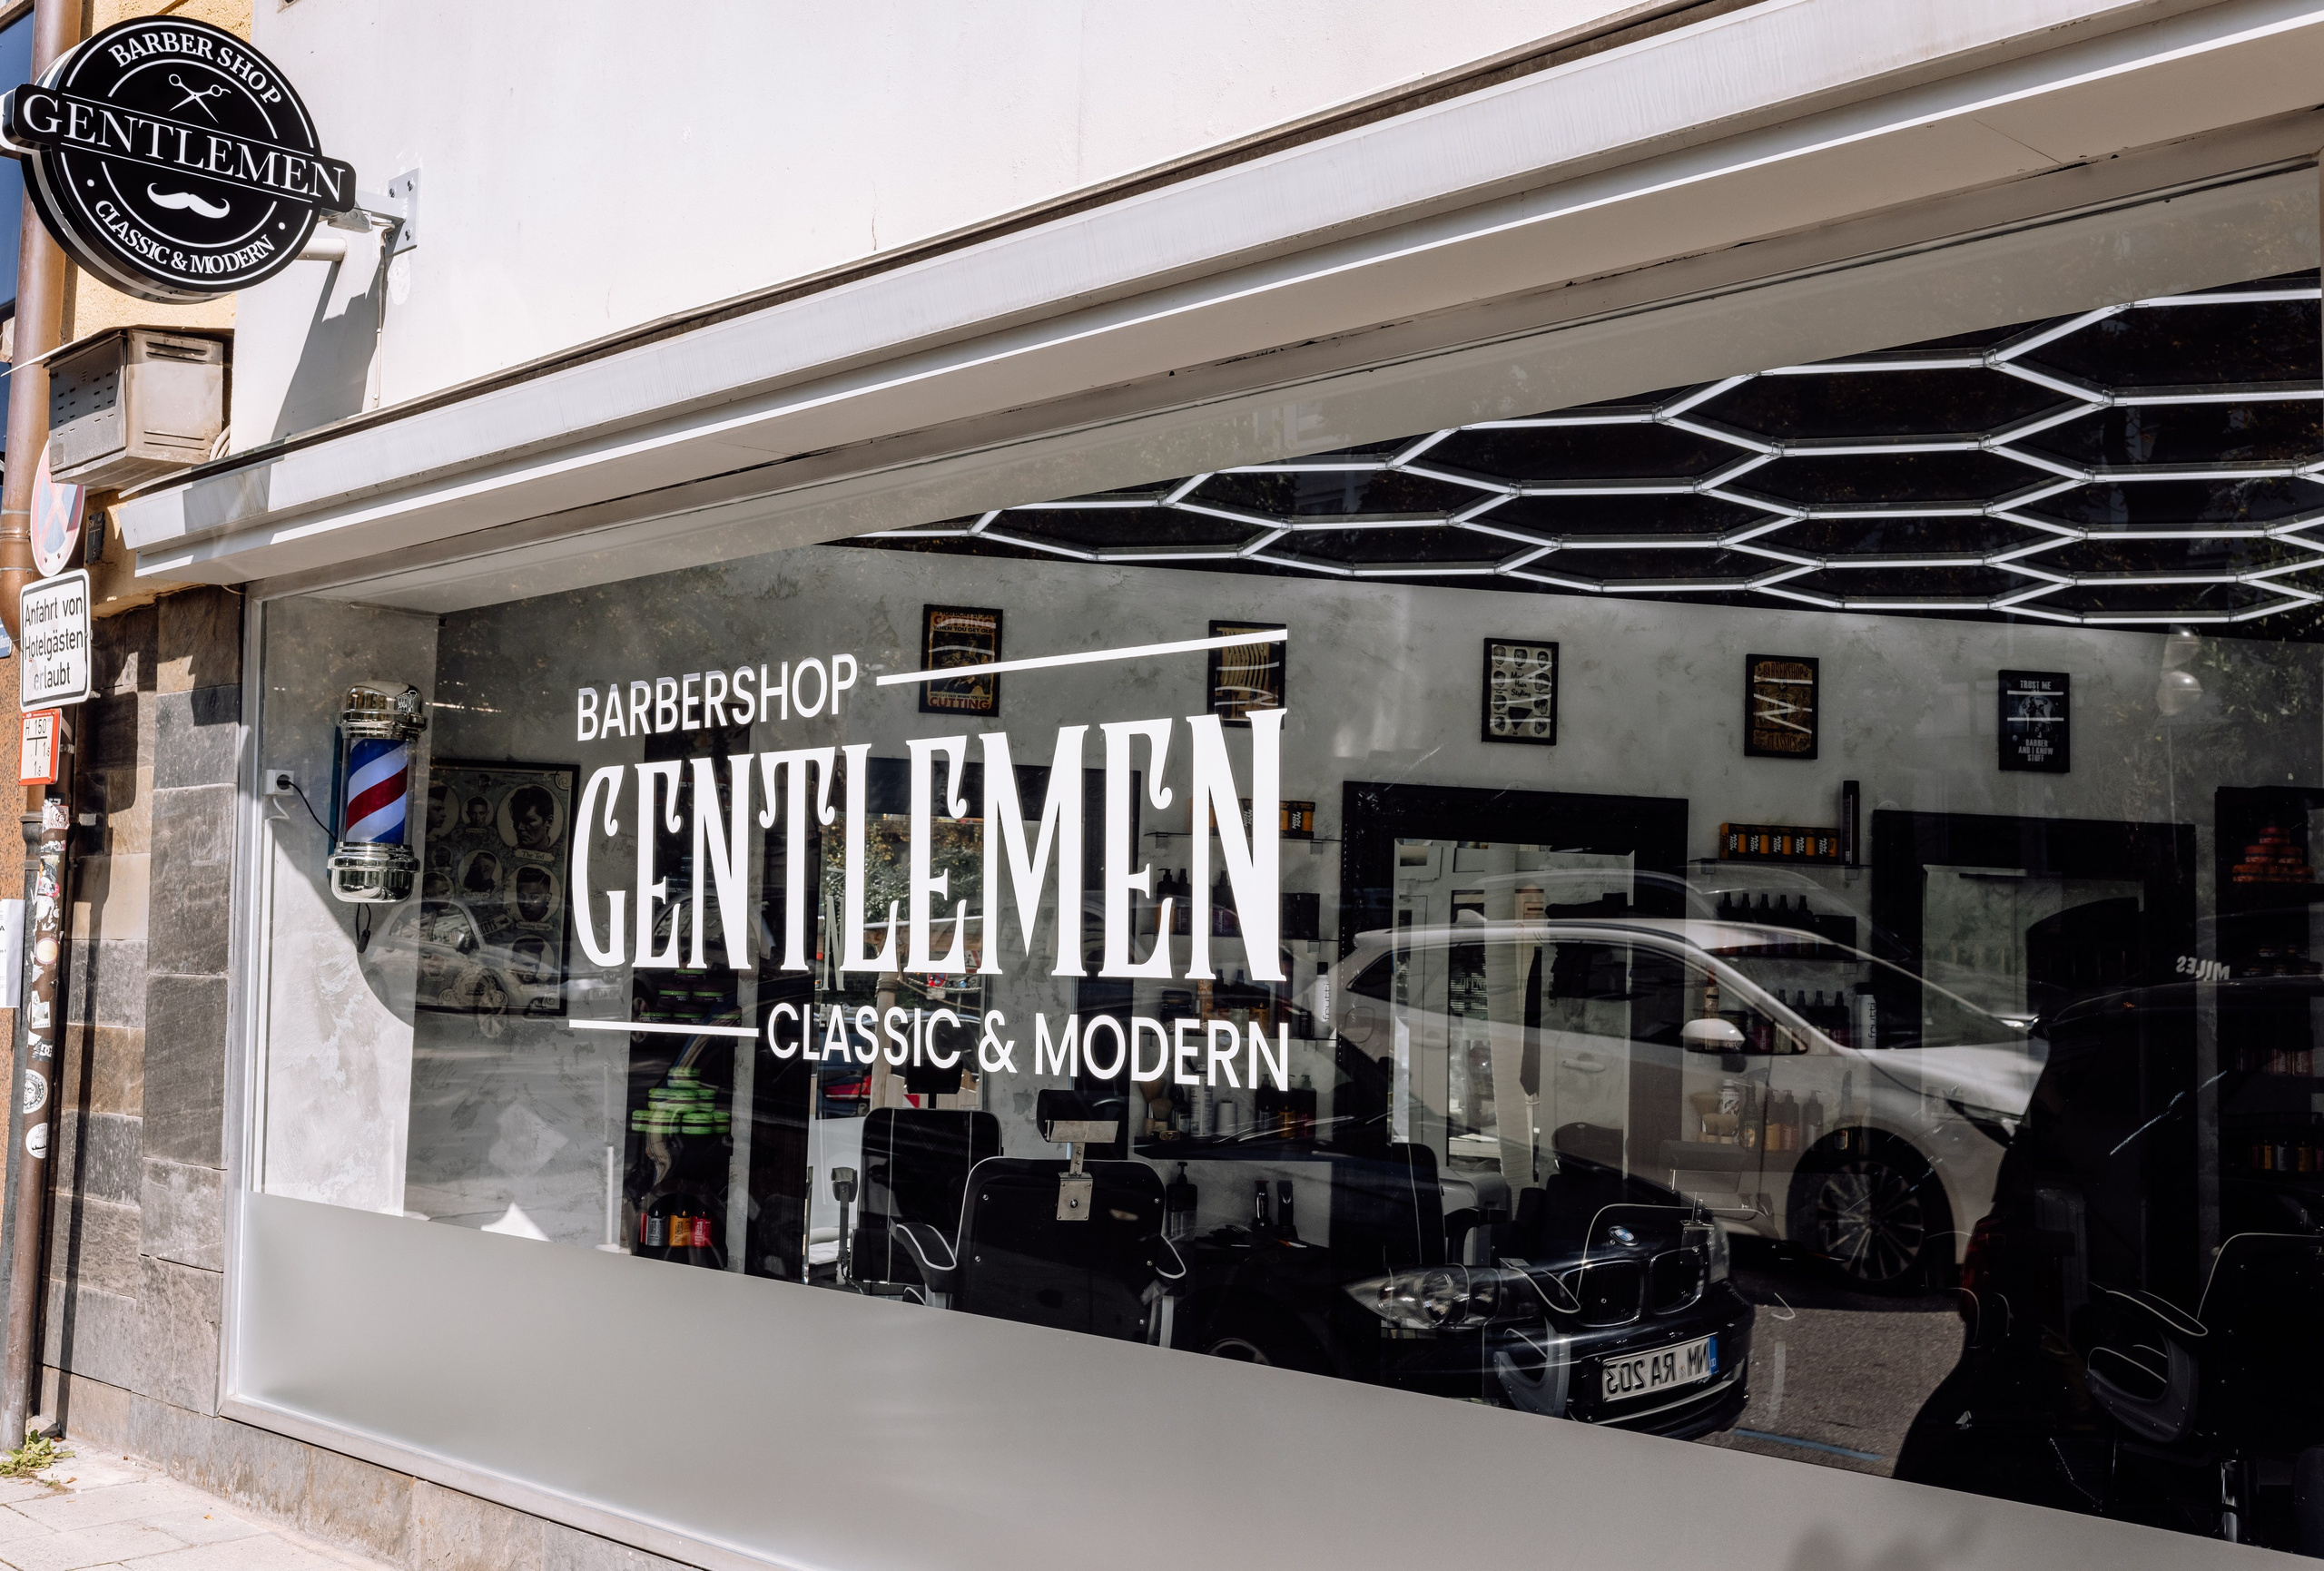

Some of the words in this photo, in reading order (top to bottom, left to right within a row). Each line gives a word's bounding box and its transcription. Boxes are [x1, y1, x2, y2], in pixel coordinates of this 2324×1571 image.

[108, 32, 214, 68] BARBER
[217, 47, 282, 105] SHOP
[23, 93, 346, 202] GENTLEMEN
[94, 200, 172, 266] CLASSIC
[171, 250, 188, 270] &
[190, 234, 276, 274] MODERN
[25, 597, 58, 628] Anfahrt
[63, 596, 83, 617] von
[25, 628, 84, 662] Hotelgästen
[34, 662, 71, 691] erlaubt
[2020, 680, 2040, 690] TRUST
[2042, 682, 2052, 691] ME
[577, 653, 858, 741] BARBERSHOP
[930, 697, 990, 710] CUTTING
[25, 720, 31, 736] H
[34, 718, 47, 735] 150
[2025, 739, 2048, 747] BARBER
[2018, 746, 2031, 754] AND
[2035, 747, 2053, 755] KNOW
[2027, 754, 2044, 762] STUFF
[521, 850, 534, 859] The
[571, 708, 1288, 982] GENTLEMEN
[1868, 1002, 1876, 1038] frutti
[768, 1001, 964, 1069] CLASSIC
[979, 1009, 1018, 1074] &
[1035, 1012, 1289, 1092] MODERN
